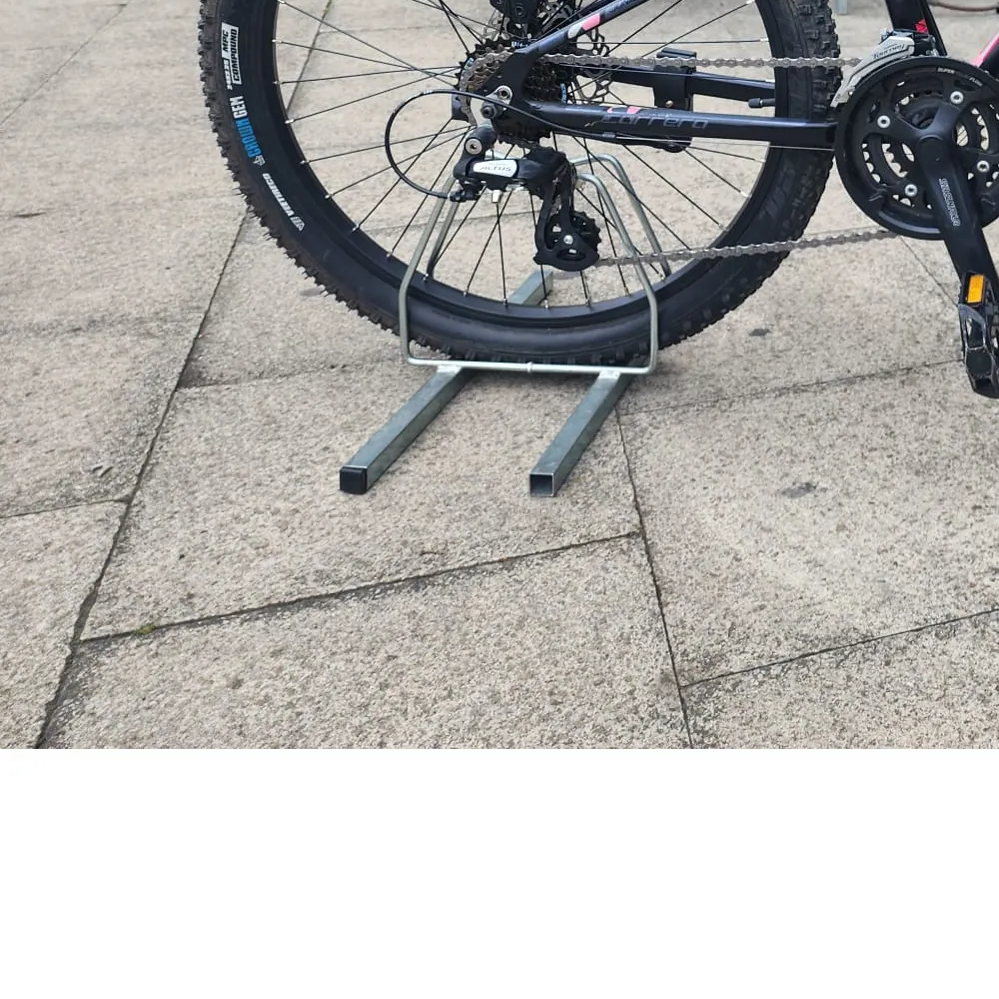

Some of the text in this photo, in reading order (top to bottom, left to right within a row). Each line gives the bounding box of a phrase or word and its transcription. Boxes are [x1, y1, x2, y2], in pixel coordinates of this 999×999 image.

[222, 29, 230, 53] MPC
[229, 28, 240, 83] COMPOUND
[229, 95, 263, 159] CROWN GEM
[602, 113, 709, 129] carrera
